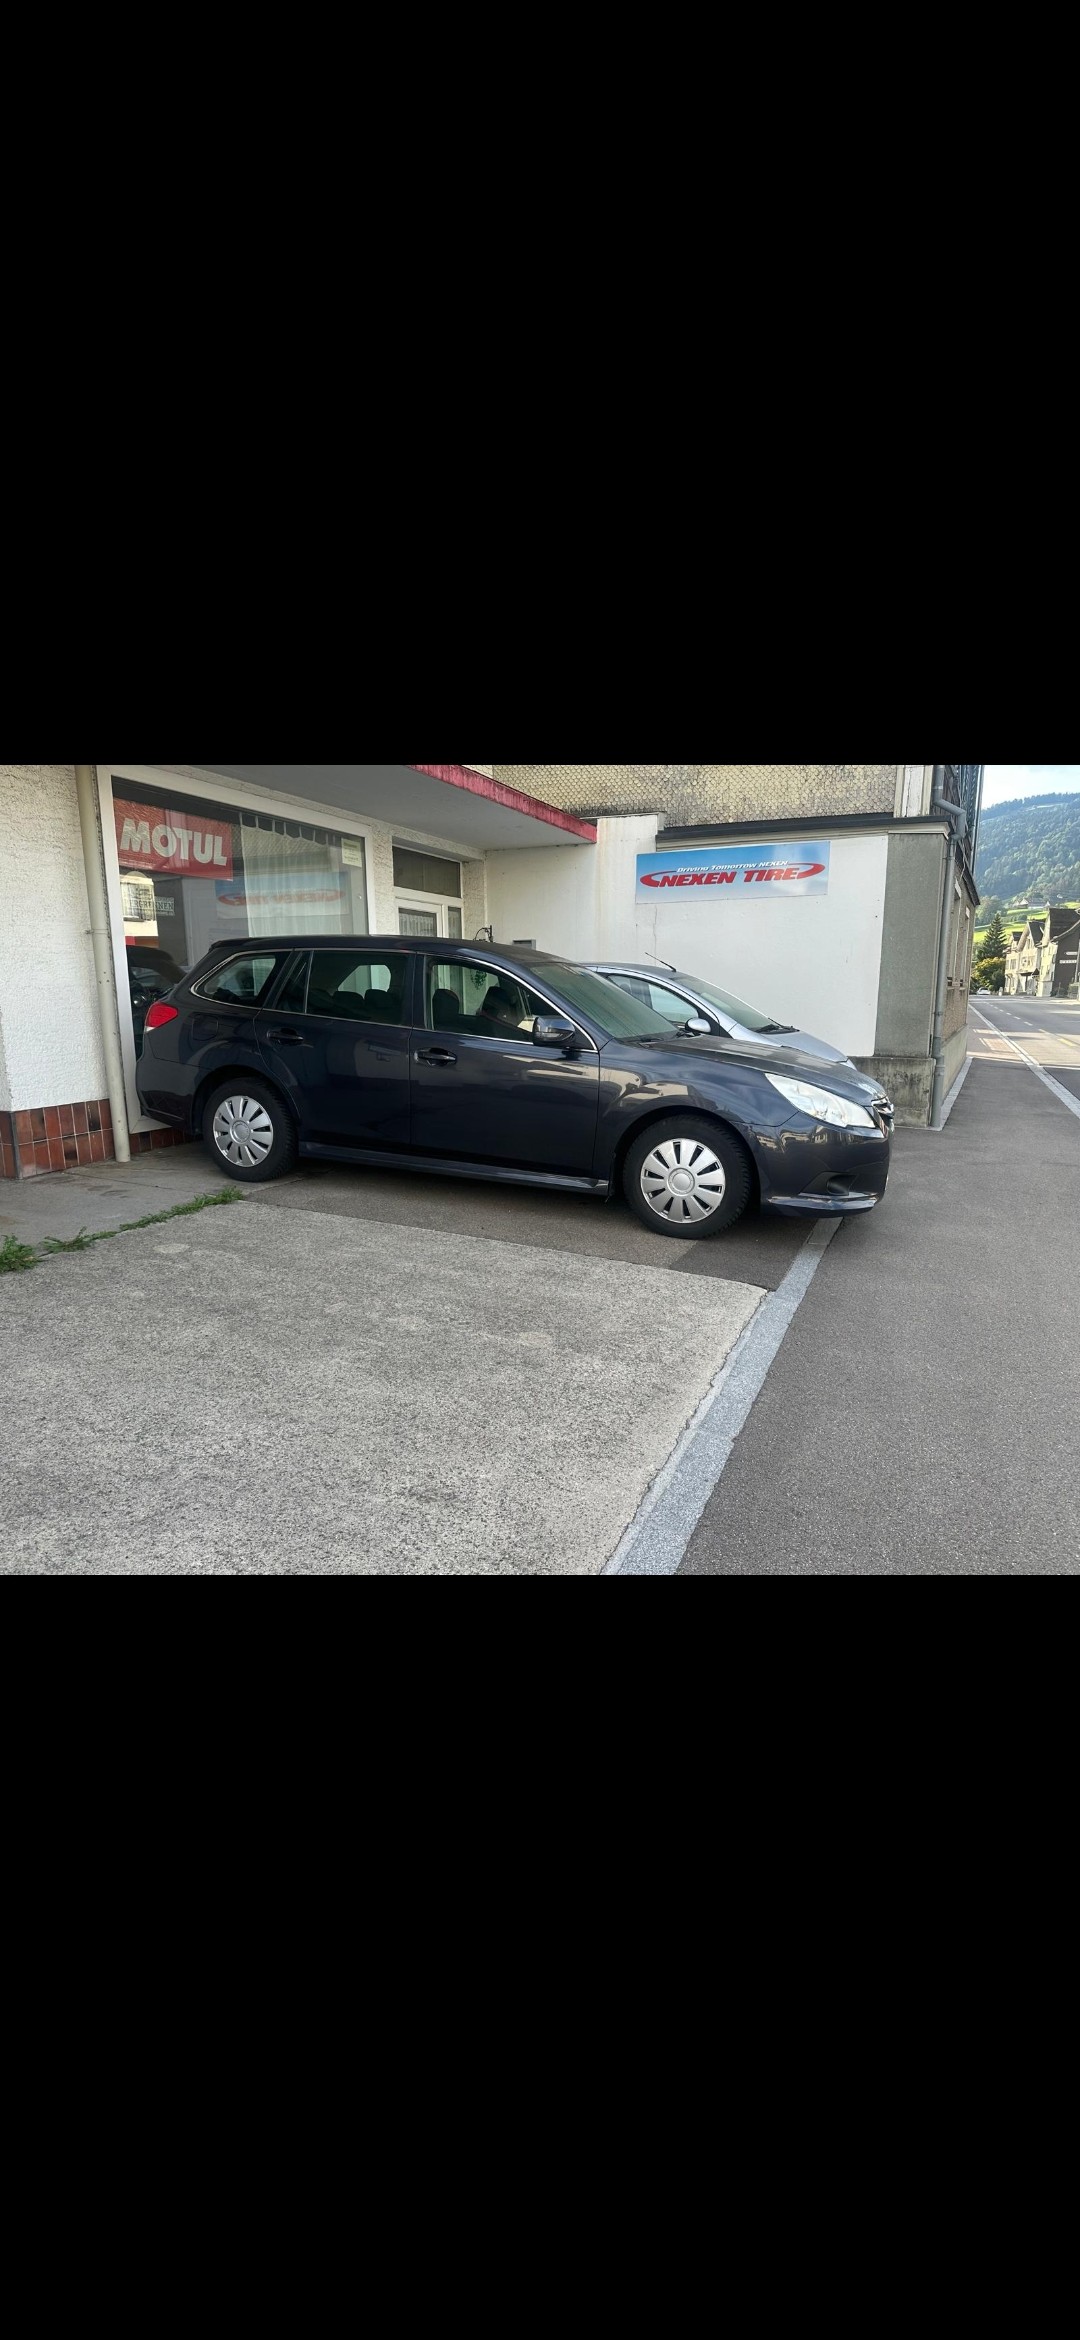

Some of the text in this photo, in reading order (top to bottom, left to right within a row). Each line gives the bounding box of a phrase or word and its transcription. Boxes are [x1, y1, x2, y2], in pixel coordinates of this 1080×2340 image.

[119, 817, 228, 867] MOTUL
[658, 867, 800, 888] NEXEN TIRE
